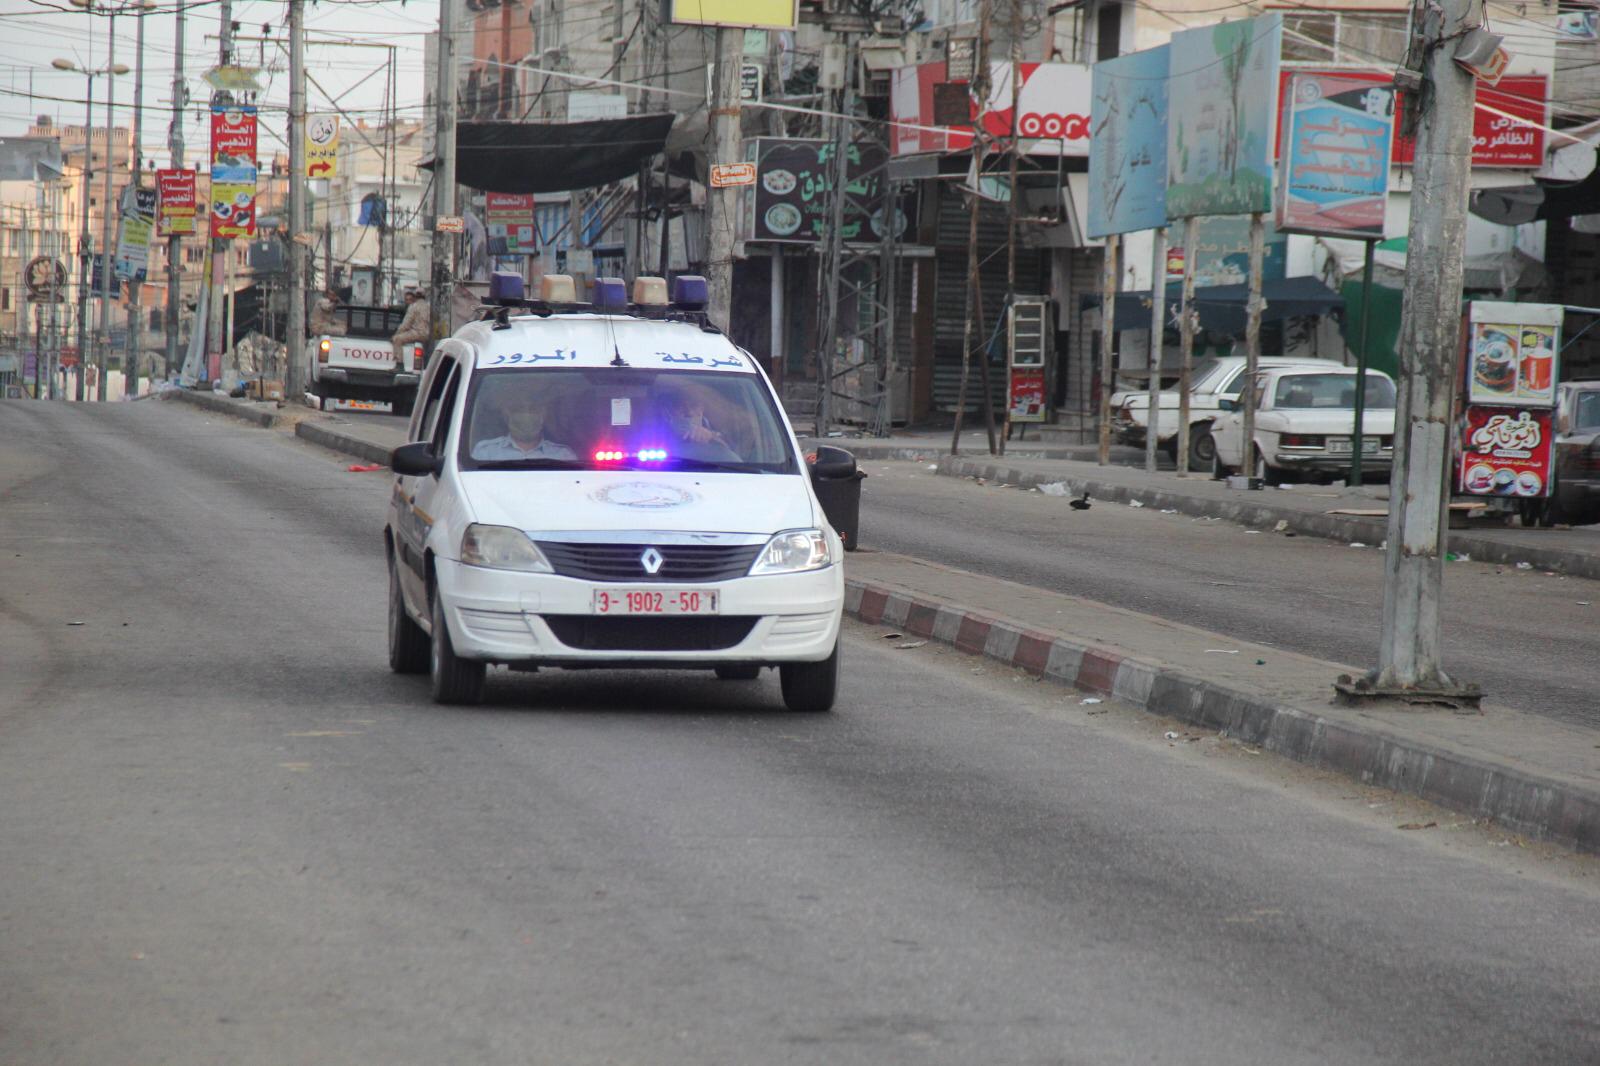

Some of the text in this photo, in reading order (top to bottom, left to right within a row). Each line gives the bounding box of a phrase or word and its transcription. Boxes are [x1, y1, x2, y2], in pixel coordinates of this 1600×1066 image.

[342, 347, 396, 361] TOYOT
[488, 348, 744, 368] شرطة المرور
